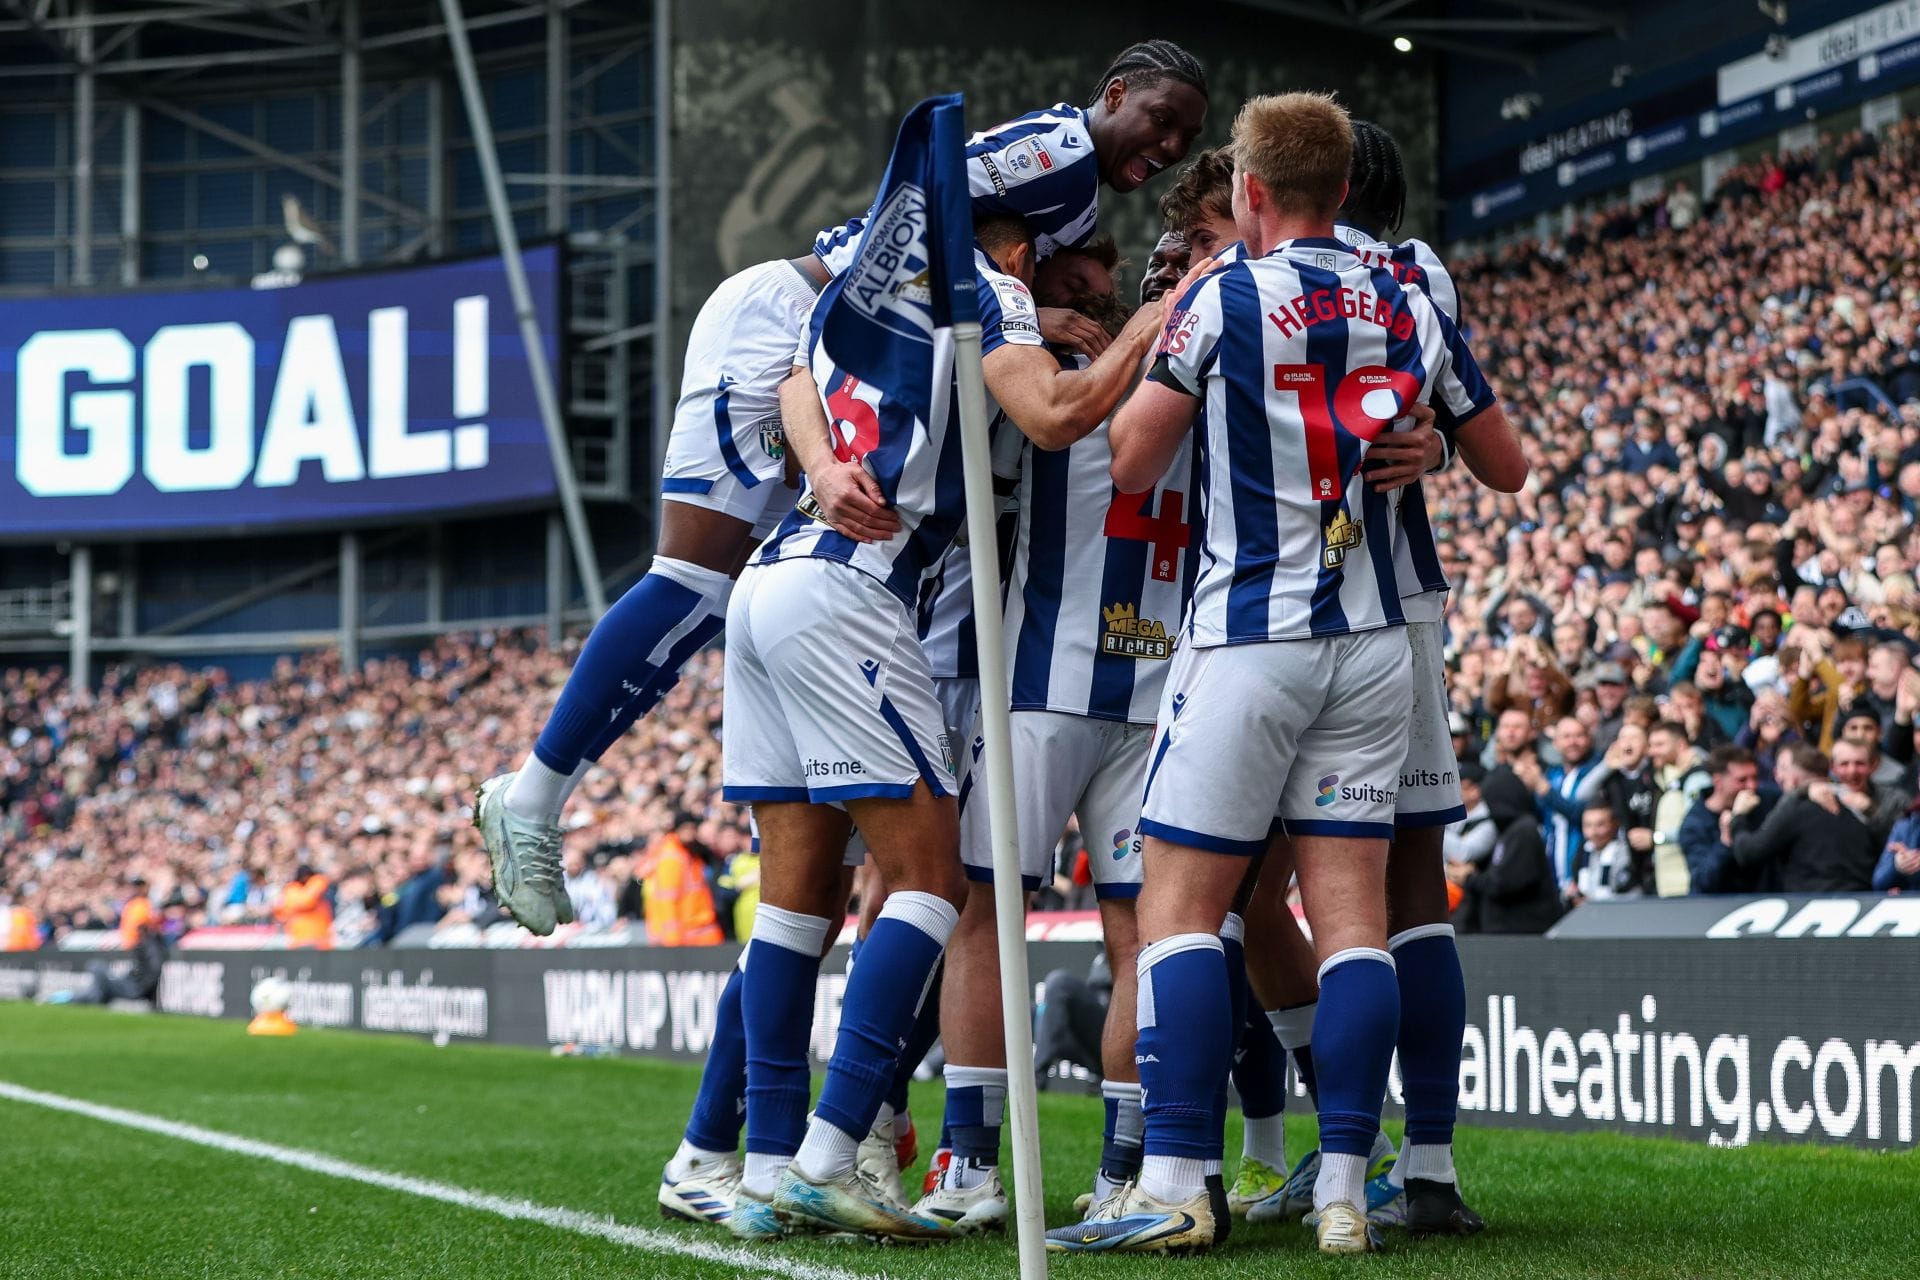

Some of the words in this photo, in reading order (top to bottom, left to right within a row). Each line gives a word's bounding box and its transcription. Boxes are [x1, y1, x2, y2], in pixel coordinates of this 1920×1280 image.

[856, 198, 927, 310] ALBION
[864, 193, 911, 260] BROMWICH
[16, 295, 490, 497] GOAL!
[760, 422, 784, 432] ALBIO
[1104, 488, 1191, 583] 4
[1106, 636, 1165, 656] RICHES
[1109, 618, 1166, 638] MEGA
[833, 761, 867, 775] me.
[1341, 783, 1384, 804] suits
[544, 969, 625, 1045] WARM
[626, 970, 668, 1050] UP
[1388, 994, 1920, 1149] alheating.com
